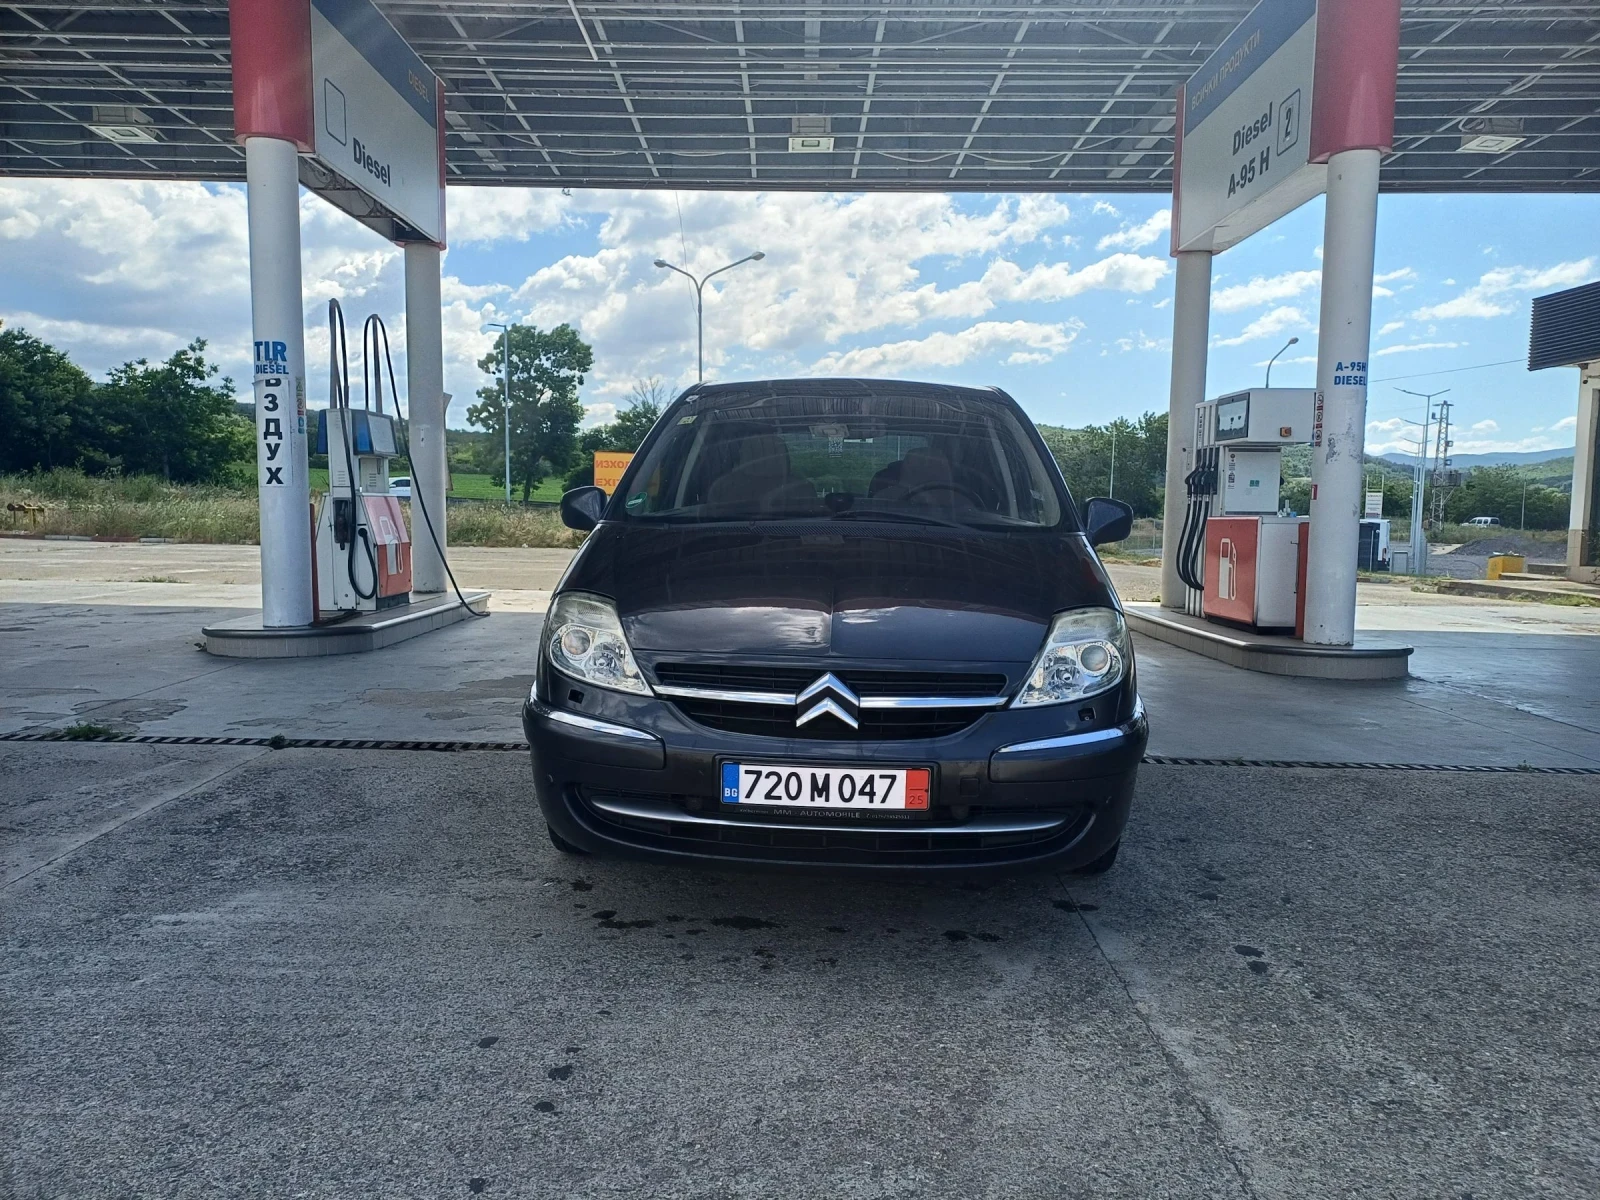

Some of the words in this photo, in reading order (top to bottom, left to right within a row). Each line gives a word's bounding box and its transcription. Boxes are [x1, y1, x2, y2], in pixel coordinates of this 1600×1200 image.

[1191, 73, 1218, 111] ВСИЧКИ
[1219, 29, 1260, 82] ПРОДУКТИ
[408, 69, 430, 103] DIESEL
[1232, 101, 1273, 155] Diesel
[1284, 107, 1292, 139] 2
[352, 137, 391, 187] Diesel
[254, 341, 287, 362] TIR
[255, 364, 289, 375] DIESEL
[1334, 375, 1366, 386] DIESEL
[724, 787, 738, 798] BG
[744, 769, 802, 801] 720
[810, 772, 830, 803] M
[838, 773, 897, 804] 047
[909, 795, 924, 805] 25
[773, 808, 792, 816] MM
[800, 809, 861, 819] AUTOMOBILE
